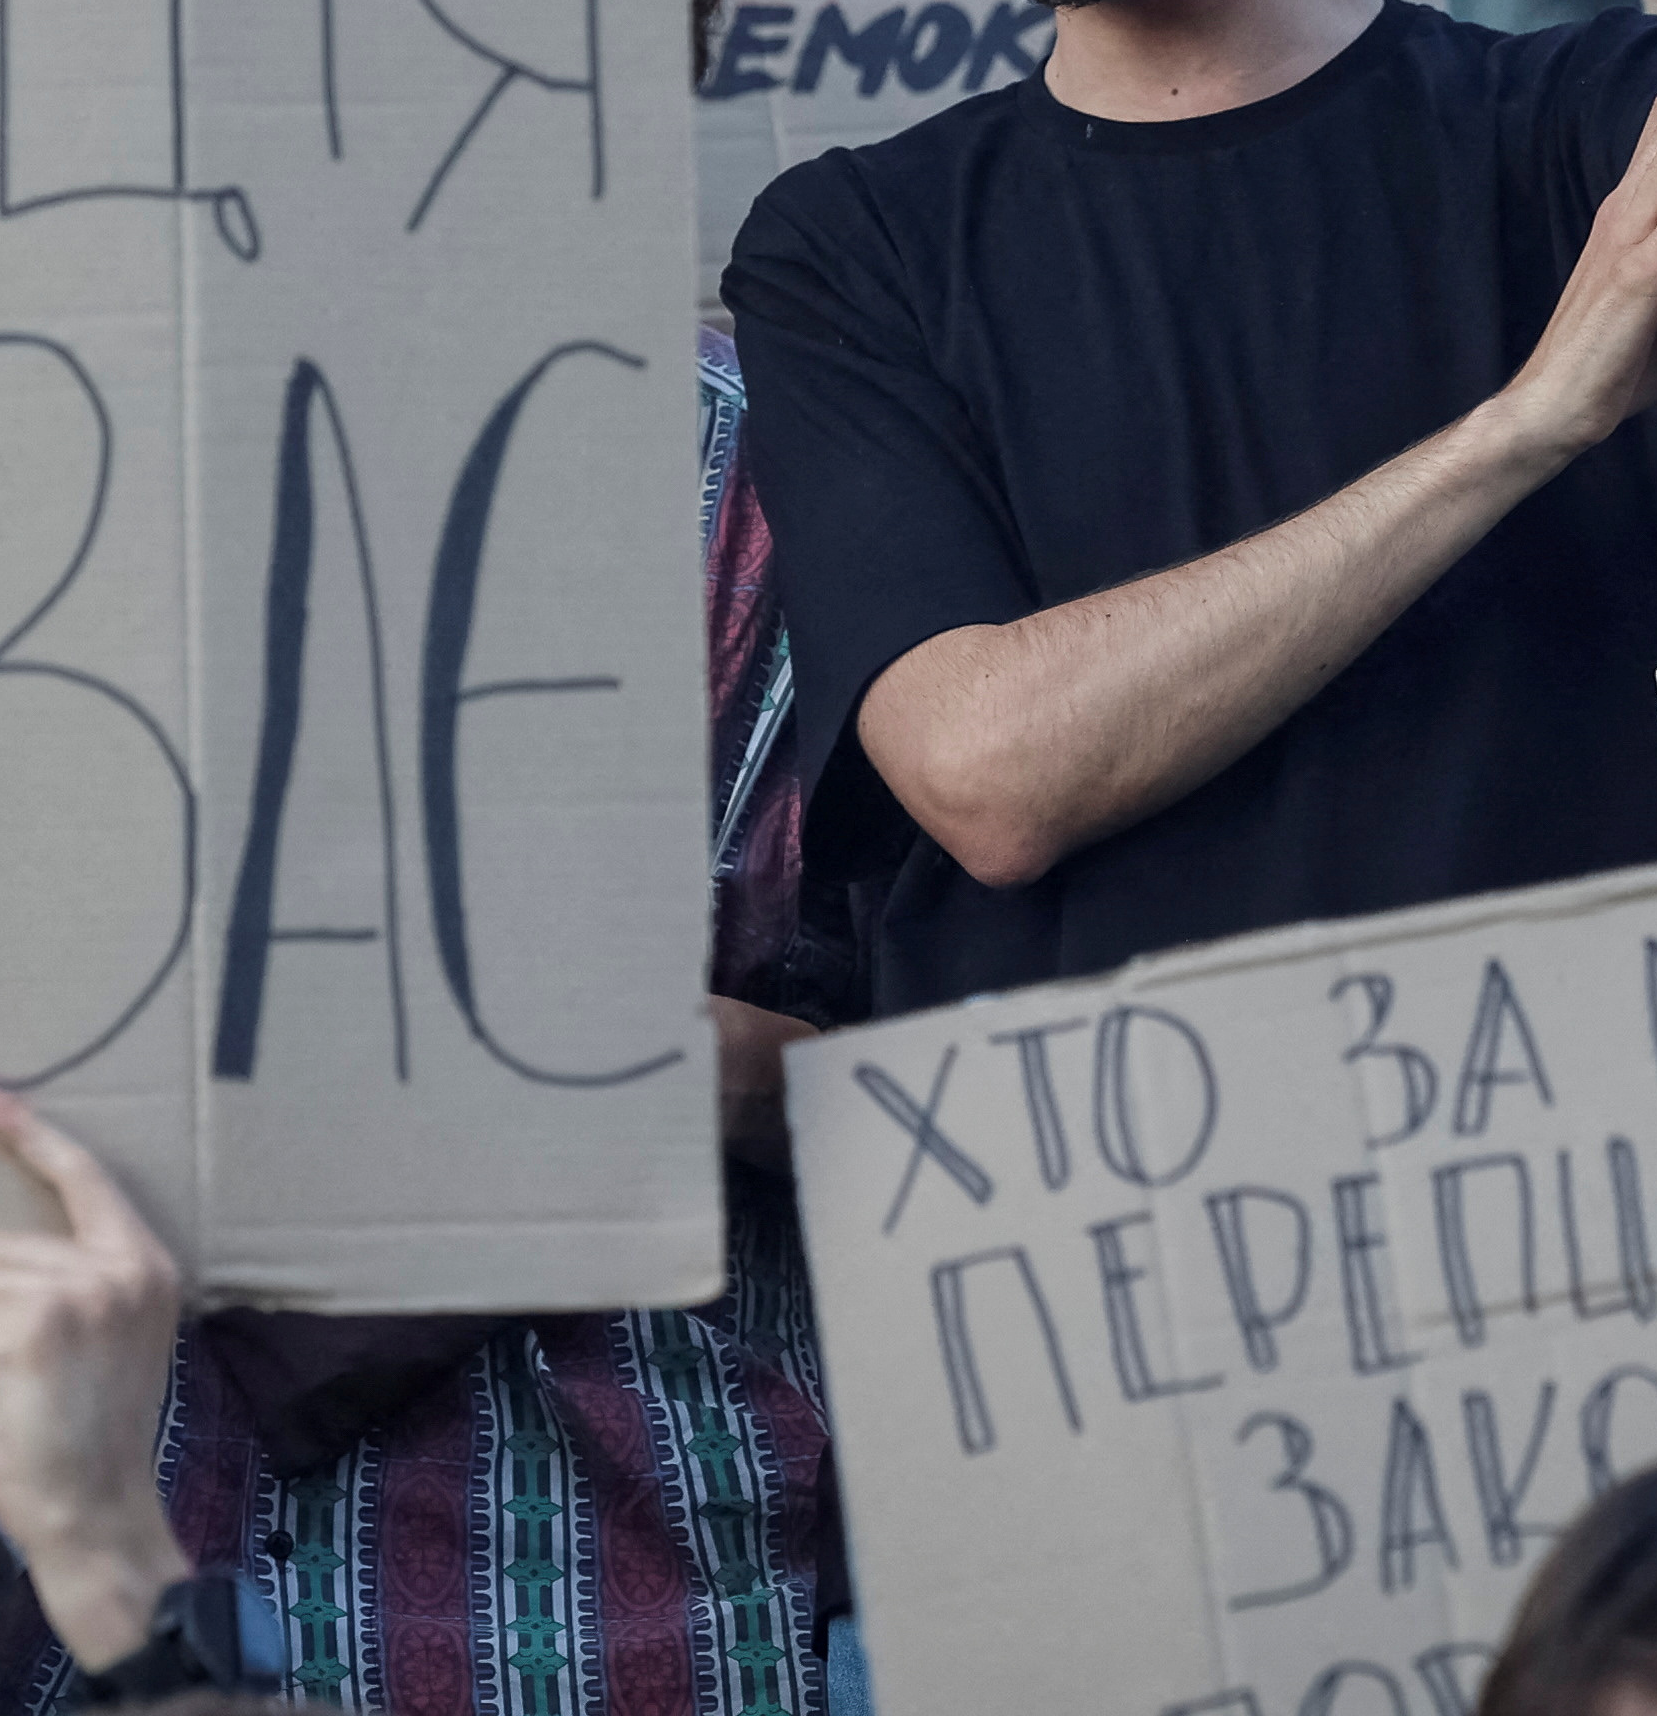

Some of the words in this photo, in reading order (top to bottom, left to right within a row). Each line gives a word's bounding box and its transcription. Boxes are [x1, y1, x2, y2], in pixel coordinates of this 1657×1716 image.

[693, 0, 1058, 104] ЕМОК
[852, 1002, 1221, 1237] ХТО
[1329, 956, 1556, 1151] ЗА
